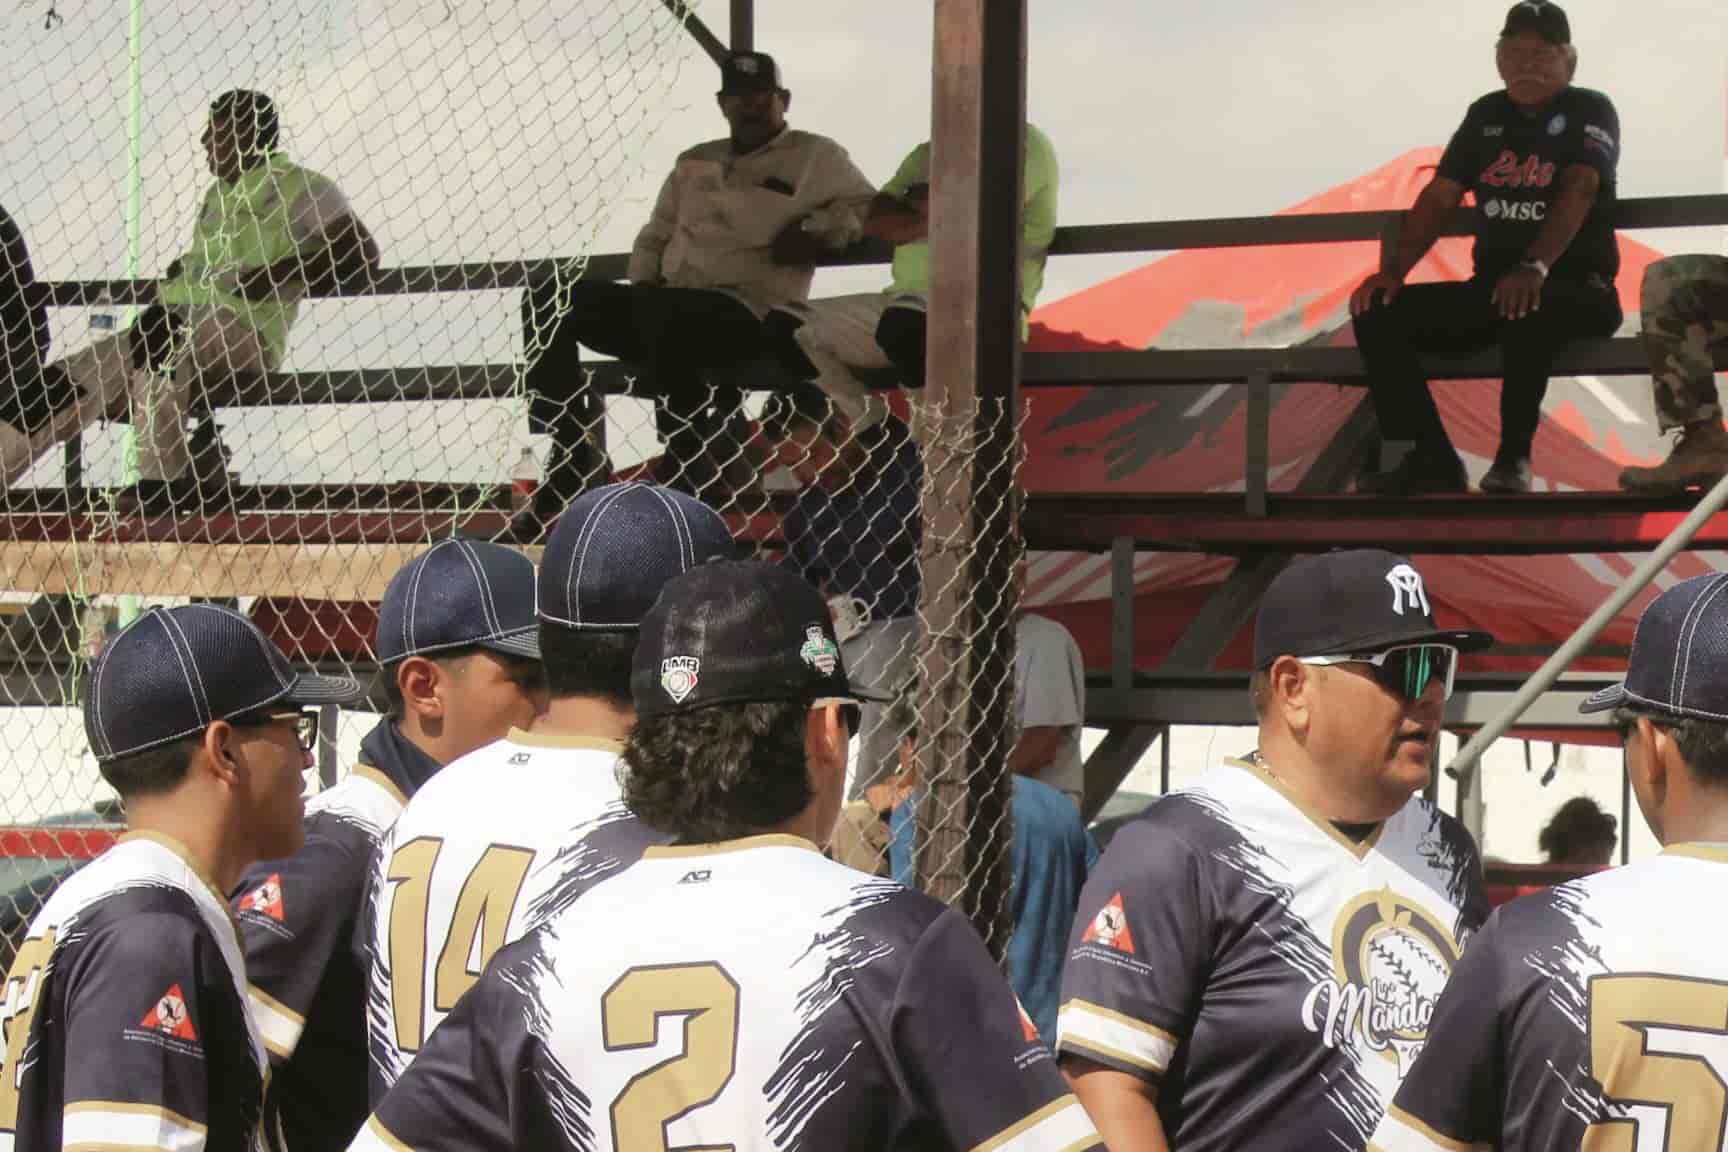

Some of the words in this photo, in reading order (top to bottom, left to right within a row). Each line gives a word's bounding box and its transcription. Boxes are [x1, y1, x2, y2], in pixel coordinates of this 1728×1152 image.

[1500, 199, 1546, 220] MSC
[387, 835, 537, 1054] 14
[1301, 979, 1441, 1050] Manda
